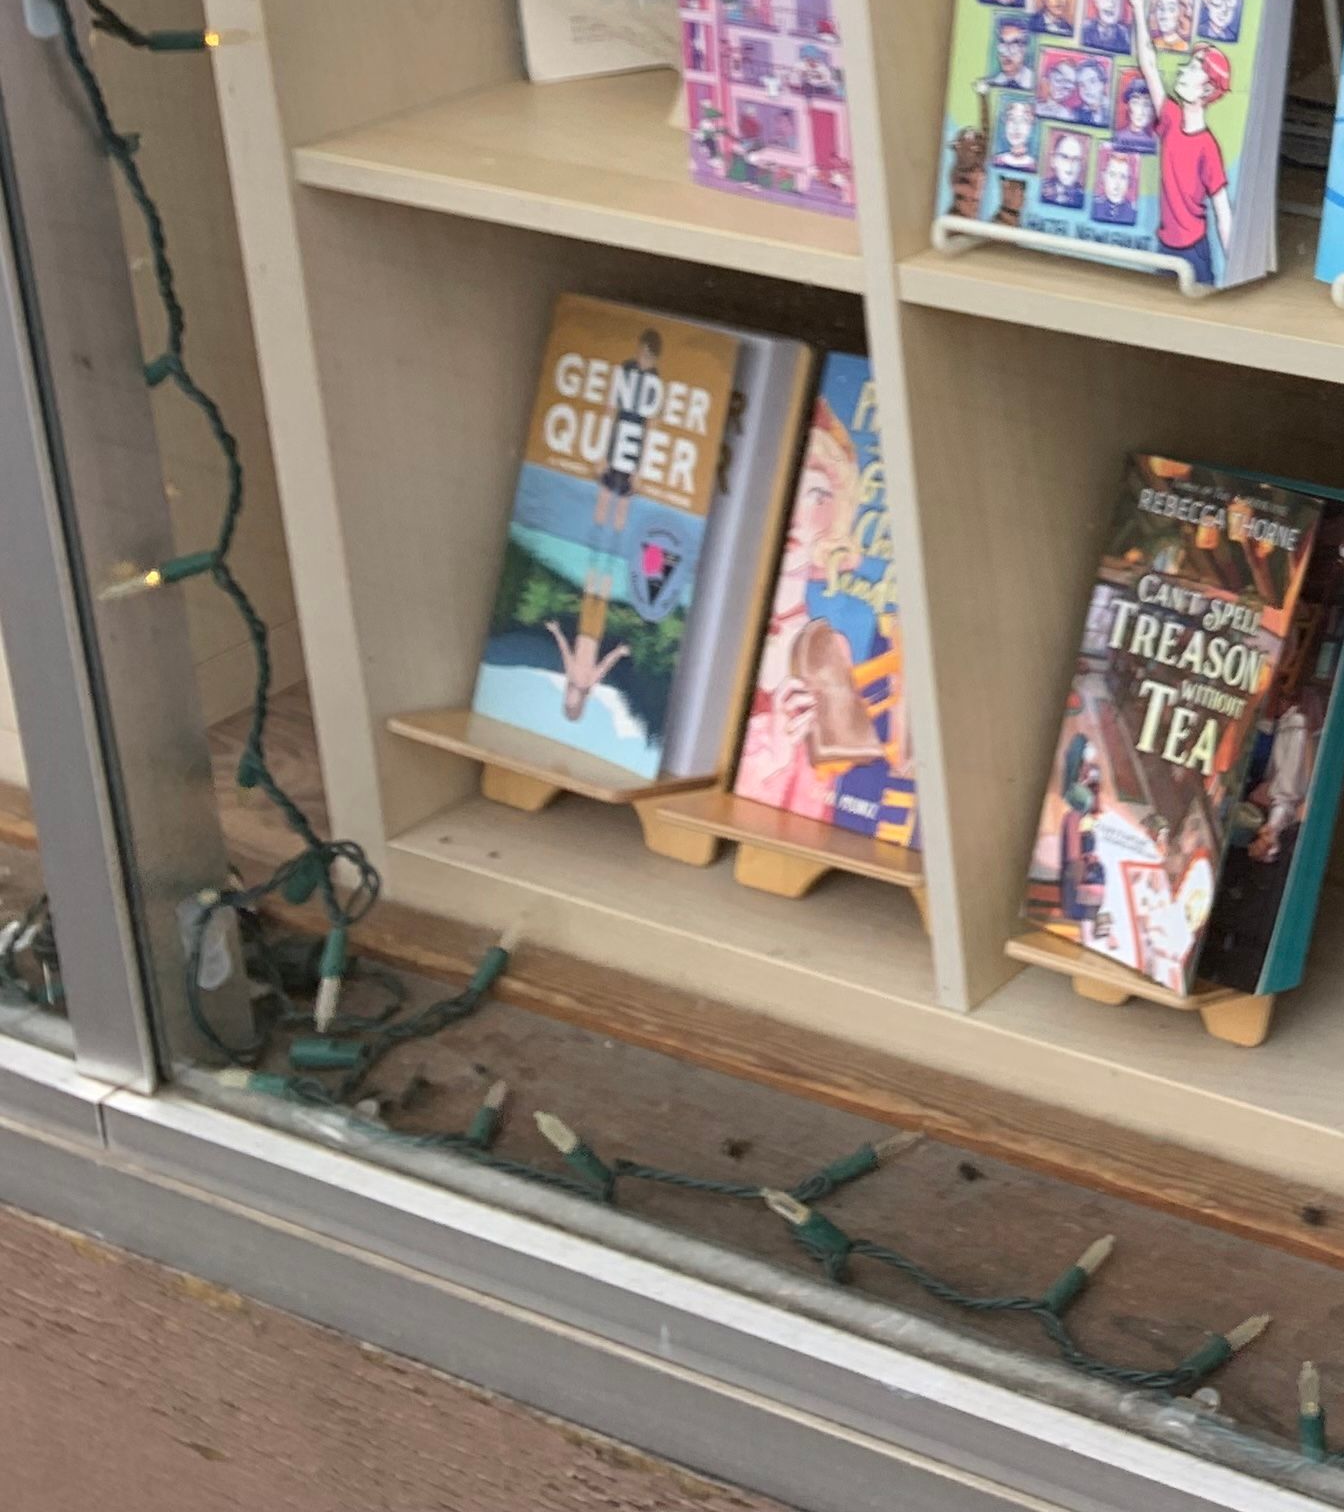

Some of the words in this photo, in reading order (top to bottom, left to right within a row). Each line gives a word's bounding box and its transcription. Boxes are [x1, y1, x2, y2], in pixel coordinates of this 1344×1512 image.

[555, 353, 711, 436] GENDER
[543, 403, 698, 495] QUEER
[1108, 597, 1269, 695] TREASON
[1138, 572, 1202, 616] CAN'T
[1203, 598, 1261, 636] SPELL
[1136, 680, 1217, 778] TEA
[1181, 679, 1247, 721] WITHOUT
